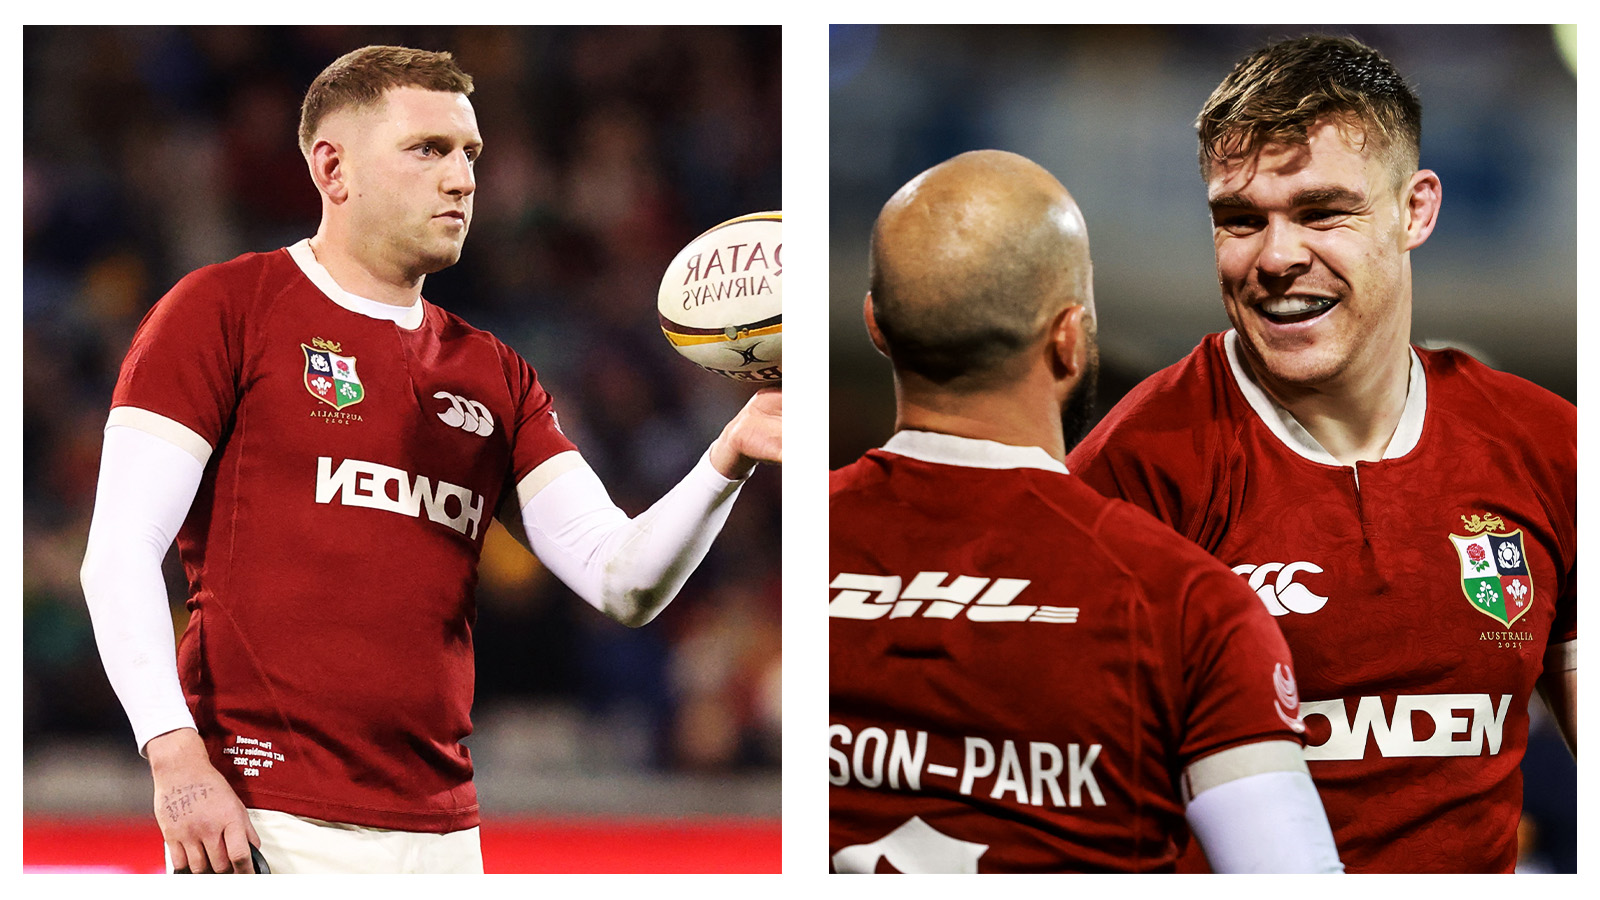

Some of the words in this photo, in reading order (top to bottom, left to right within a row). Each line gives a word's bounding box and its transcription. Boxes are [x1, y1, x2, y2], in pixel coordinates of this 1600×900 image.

[829, 571, 1038, 622] DHL
[1479, 631, 1534, 641] AUSTRALIA
[1498, 641, 1522, 650] 2025
[1300, 693, 1513, 761] OWDEN
